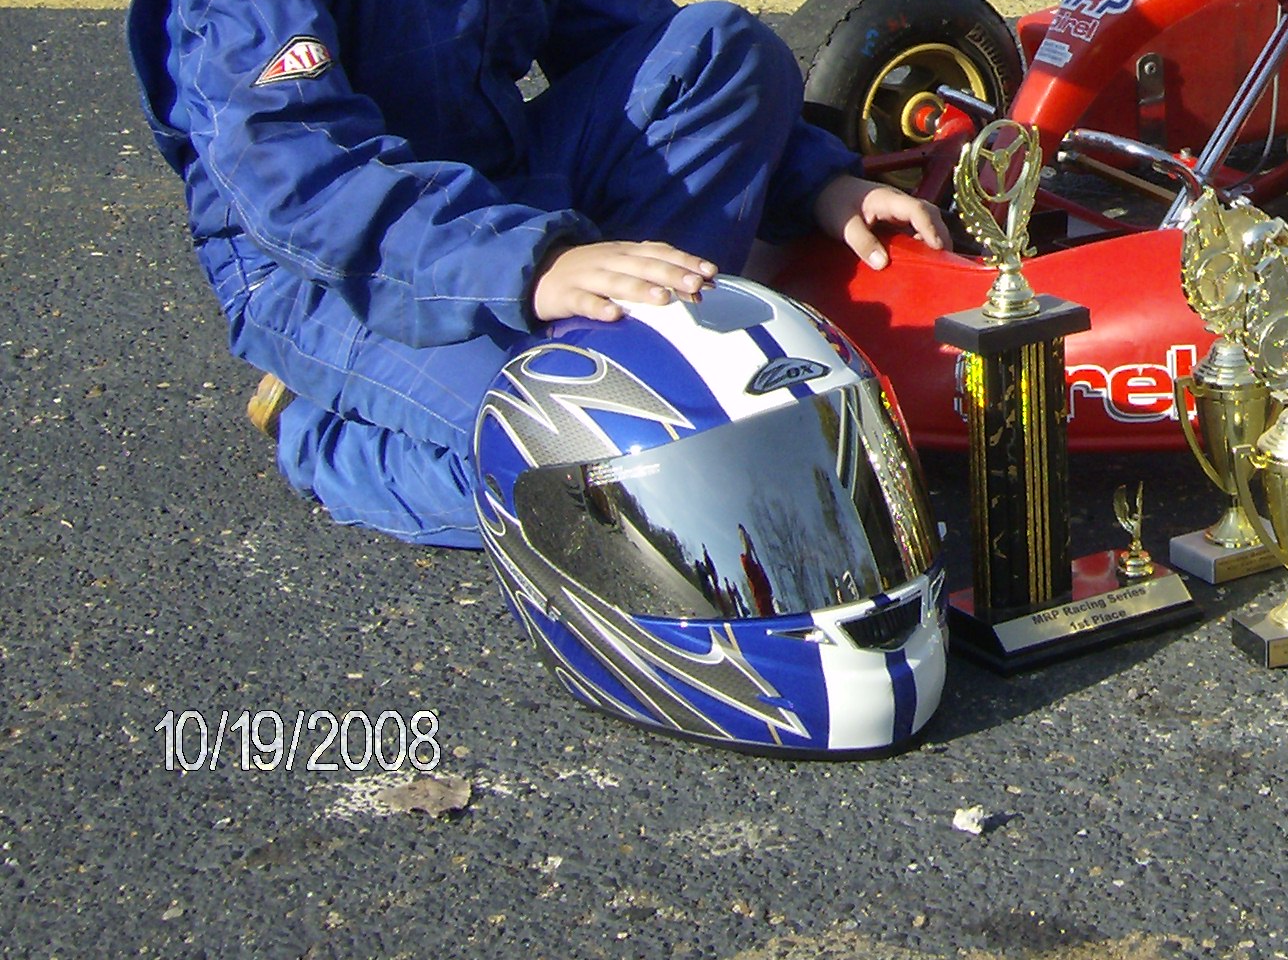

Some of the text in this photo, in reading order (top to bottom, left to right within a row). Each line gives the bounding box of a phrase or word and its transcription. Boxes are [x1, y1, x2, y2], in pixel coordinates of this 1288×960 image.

[283, 42, 328, 72] ATR
[1031, 586, 1147, 626] MRP Racing Series
[1069, 609, 1127, 631] 1st Place
